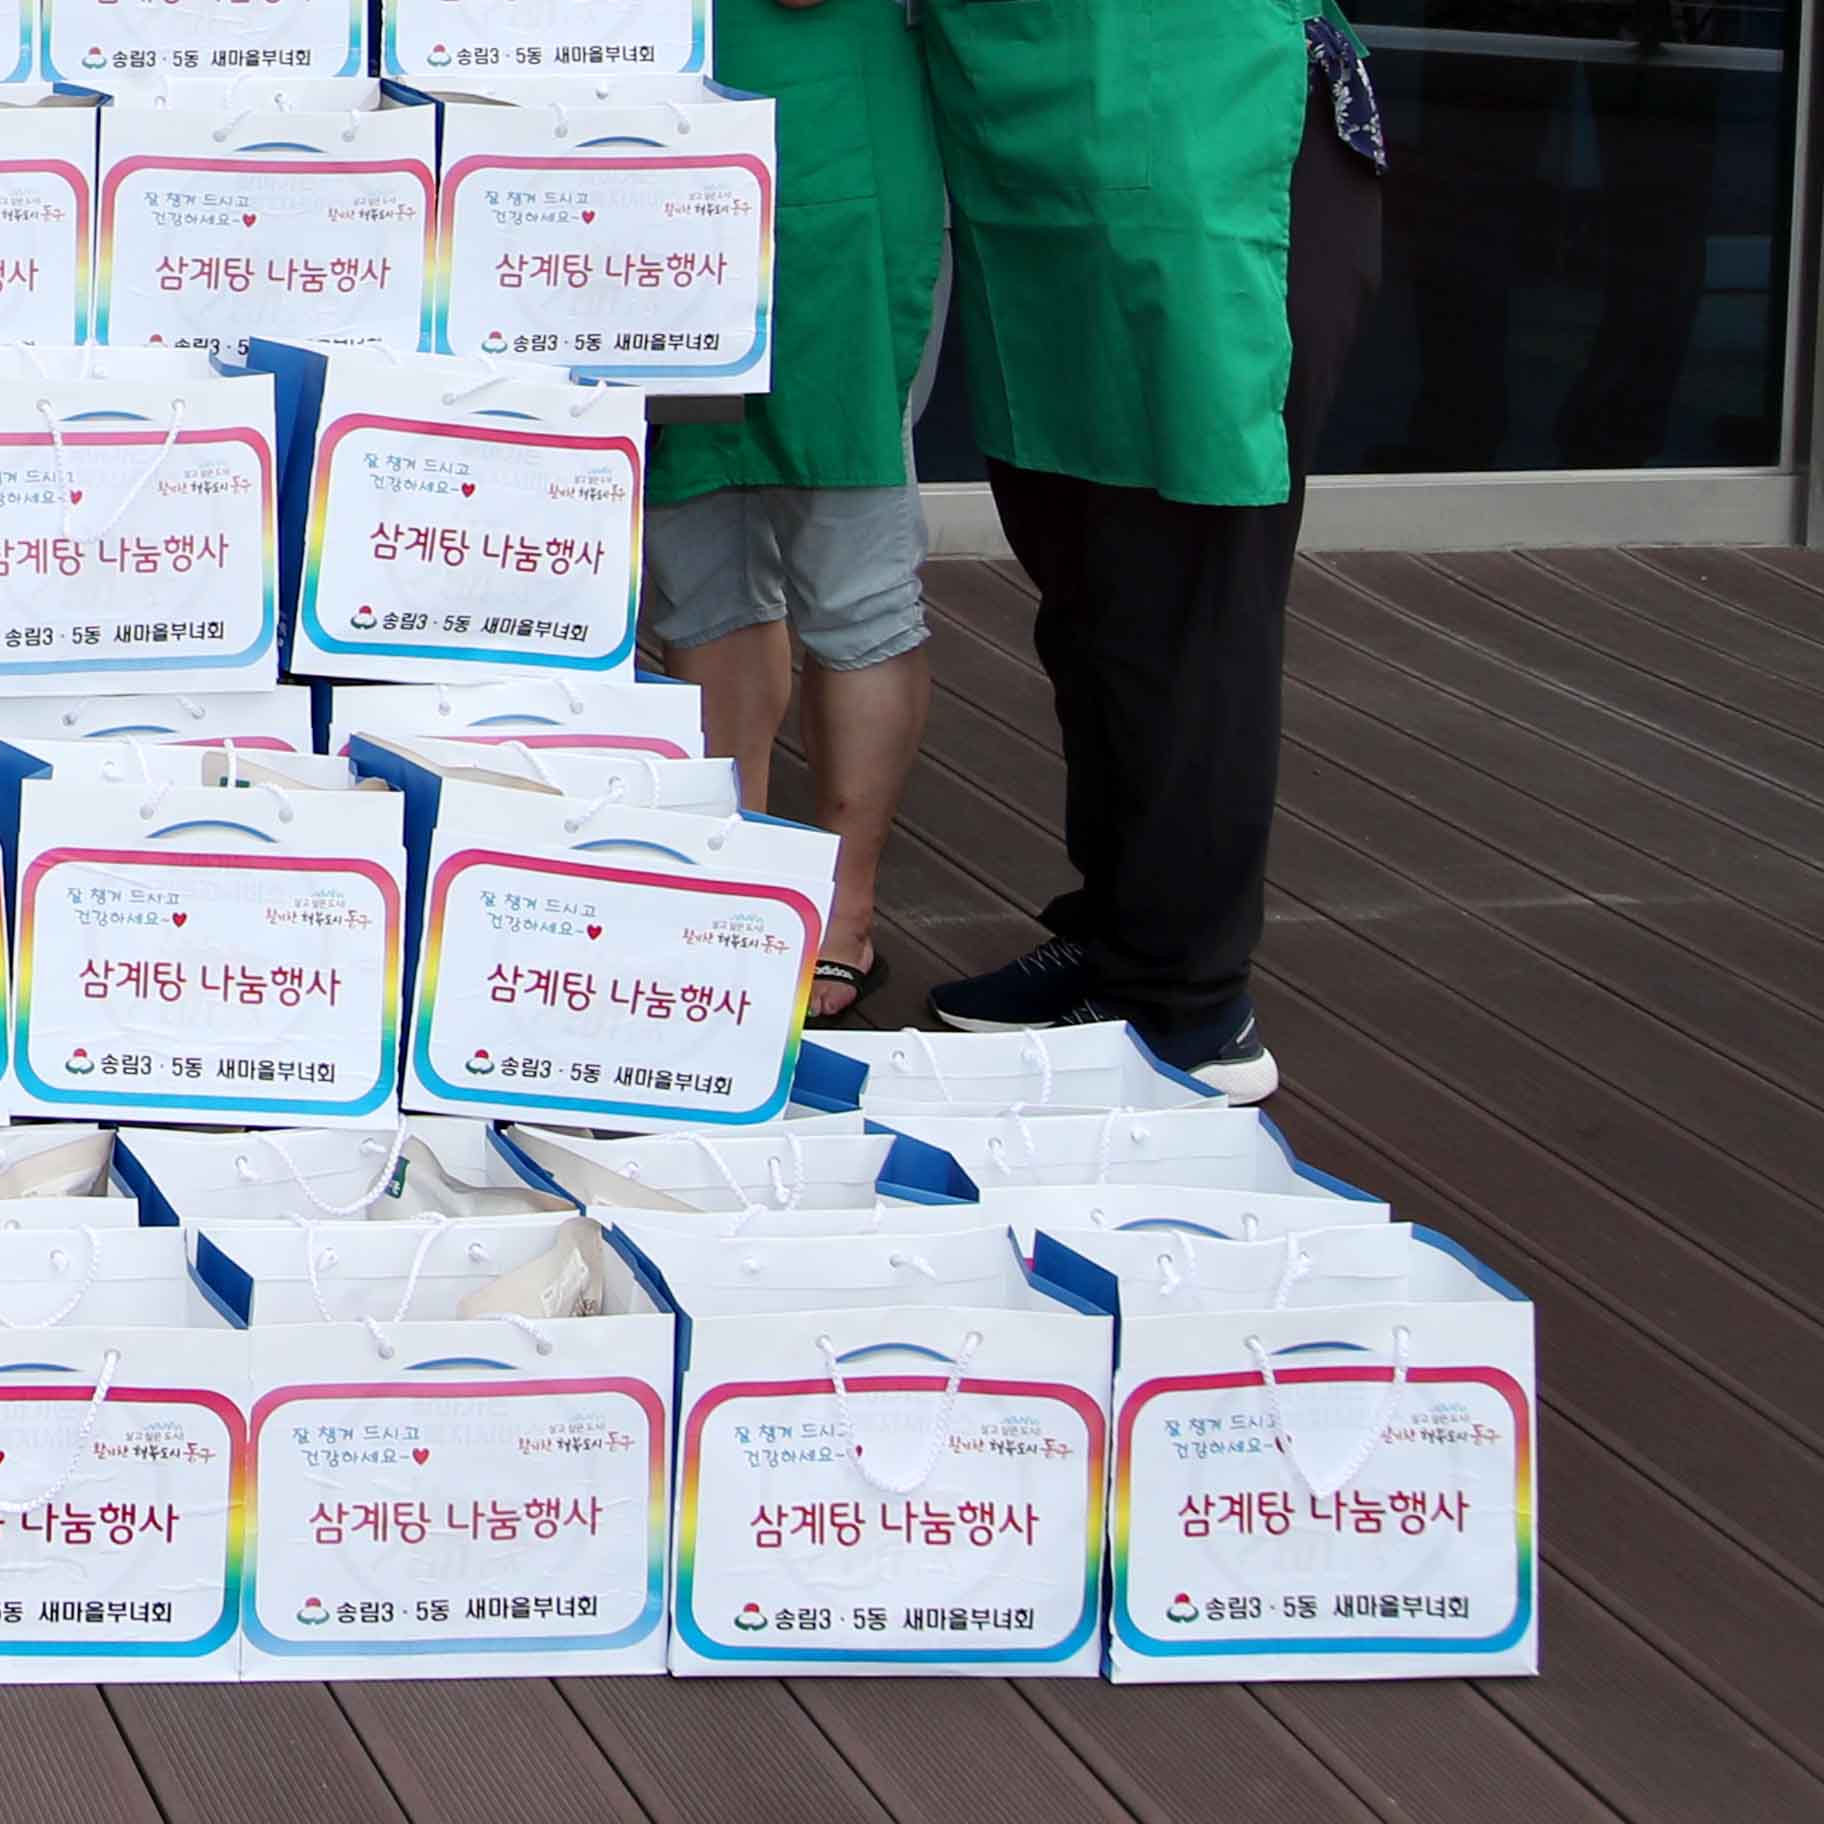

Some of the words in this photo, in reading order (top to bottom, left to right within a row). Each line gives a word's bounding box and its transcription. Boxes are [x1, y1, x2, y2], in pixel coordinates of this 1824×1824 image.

[555, 46, 654, 63] 새마을부녀회
[156, 256, 255, 292] 삼계탕
[268, 258, 391, 292] 나눔행사
[496, 254, 593, 288] 삼계탕
[606, 253, 727, 287] 나눔행사
[614, 334, 719, 351] 새마을부녀회
[99, 533, 229, 573] 나눔행사
[370, 522, 470, 566] 삼계탕
[483, 534, 604, 575] 나눔행사
[481, 617, 588, 642] 새마을부녀회
[480, 890, 497, 907] 잘
[545, 898, 597, 918] 드시고
[80, 960, 186, 1002] 삼계탕
[202, 964, 341, 1006] 나눔행사
[488, 964, 596, 1011] 삼계탕
[611, 980, 751, 1025] 나눔행사
[217, 1059, 335, 1083] 새마을부녀회
[614, 1067, 732, 1096] 새마을부녀회
[310, 1502, 431, 1544] 삼계탕
[448, 1496, 603, 1541] 나눔행사
[751, 1502, 865, 1548] 삼계탕
[881, 1501, 1039, 1546] 나눔행사
[904, 1608, 1034, 1630] 새마을부녀회
